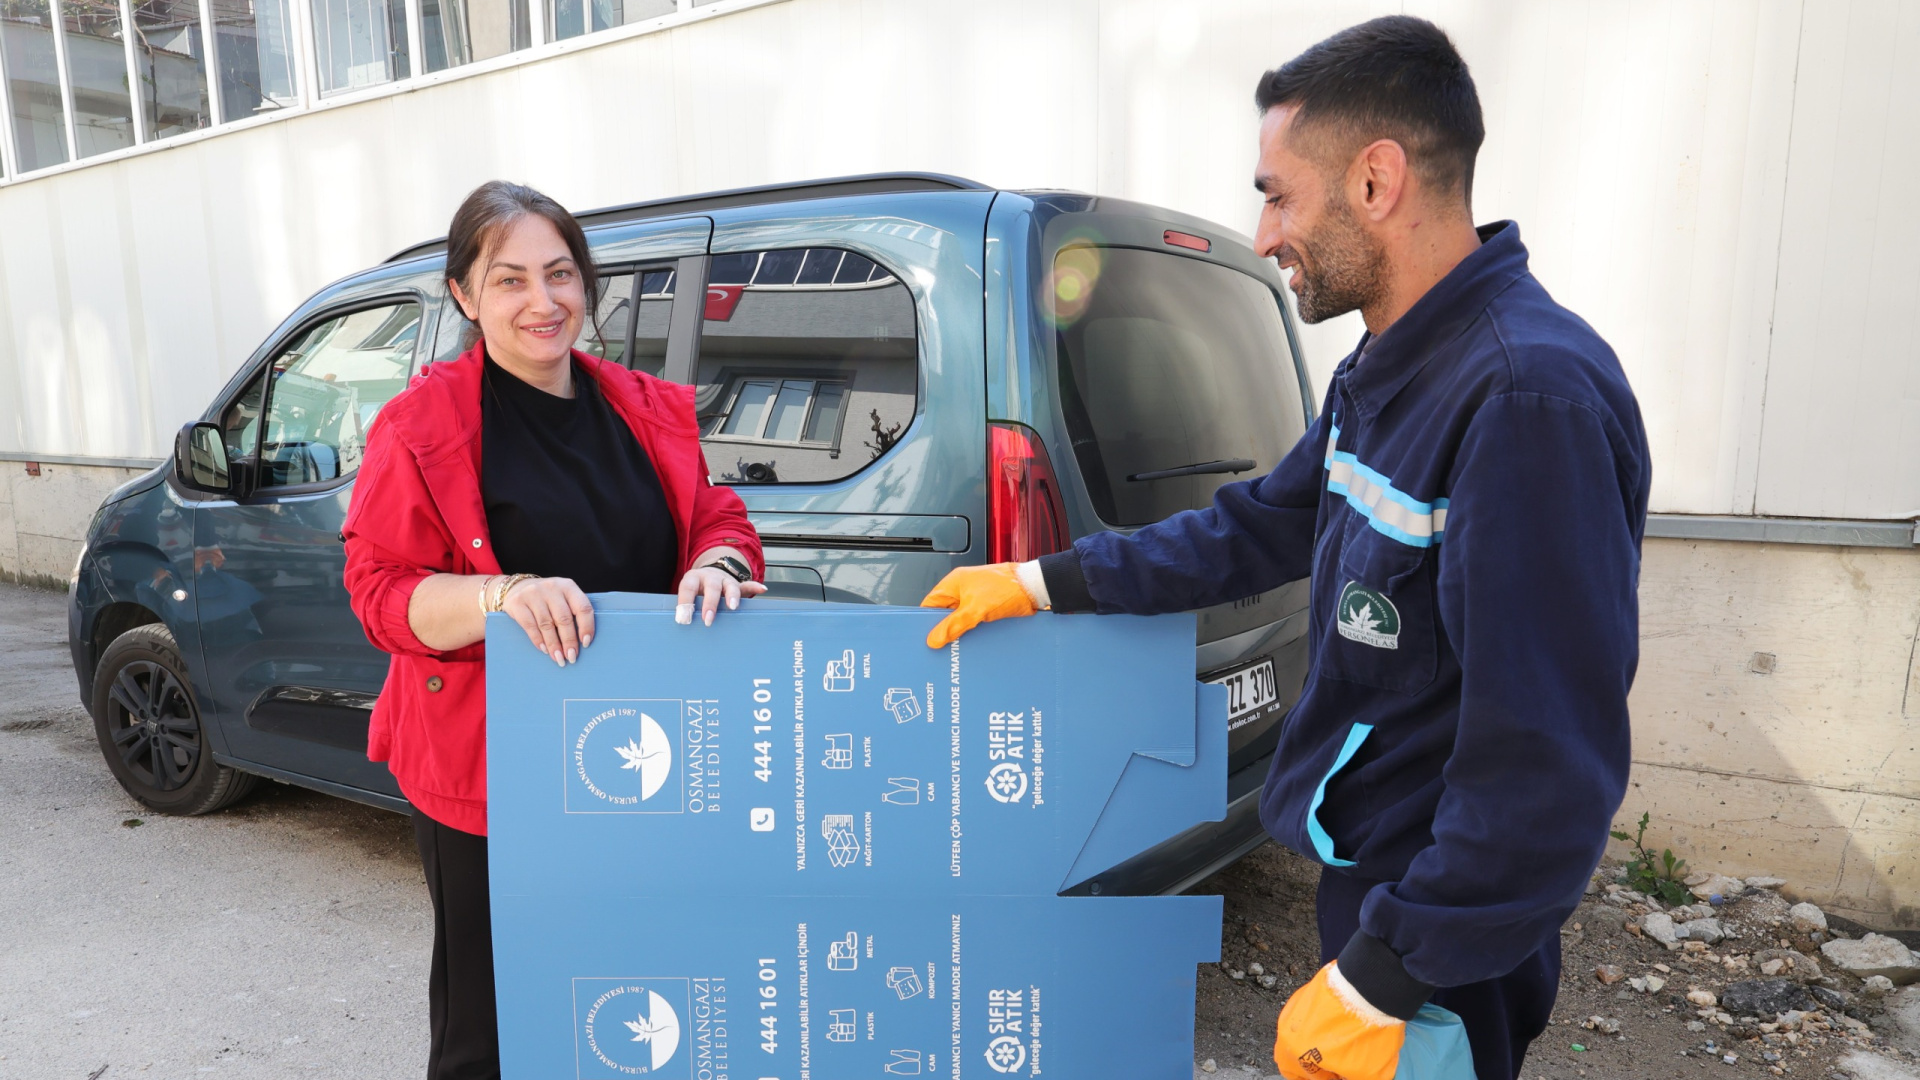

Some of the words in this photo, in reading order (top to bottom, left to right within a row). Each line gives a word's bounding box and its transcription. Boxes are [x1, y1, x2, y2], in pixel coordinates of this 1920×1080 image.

[793, 640, 806, 679] İÇİNDİR
[863, 653, 871, 678] METAL
[951, 637, 960, 684] ATMAYIN
[753, 678, 772, 703] 01
[794, 680, 804, 721] ATIKLAR
[926, 682, 934, 722] KOMPOZİT
[951, 687, 960, 724] MADDE
[1218, 675, 1247, 714] ZZ
[1250, 664, 1274, 704] 370
[576, 707, 616, 750] BELEDİYESİ
[618, 708, 637, 716] 1987
[753, 708, 772, 735] 16
[863, 737, 872, 767] PLASTİK
[951, 726, 960, 759] YANICI
[989, 711, 1006, 760] SIFIR
[1007, 711, 1024, 759] ATIK
[1031, 739, 1044, 764] değer
[685, 699, 704, 814] OSMANGAZİ
[705, 699, 721, 813] BELEDİYESİ
[754, 740, 772, 783] 444
[793, 723, 805, 798] KAZANILABİLİR
[951, 758, 960, 773] VE
[573, 751, 607, 800] OSMANGAZİ
[927, 782, 935, 802] CAM
[608, 796, 638, 805] BURSA
[795, 800, 805, 822] GERİ
[951, 774, 961, 817] YABANCI
[864, 812, 872, 867] KAĞIT-KARTON
[950, 818, 962, 837] ÇÖP
[796, 825, 806, 871] YALNIZCA
[950, 841, 961, 877] LÜTFEN
[796, 923, 810, 958] İÇİNDİR
[866, 935, 874, 958] METAL
[951, 914, 961, 964] ATMAYINIZ
[758, 958, 777, 981] 01
[799, 960, 809, 998] ATIKLAR
[928, 962, 936, 999] KOMPOZİT
[951, 966, 961, 1000] MADDE
[586, 985, 625, 1023] BELEDİYESİ
[626, 986, 645, 994] 1987
[759, 985, 777, 1010] 16
[692, 977, 713, 1080] OSMANGAZİ
[711, 977, 729, 1080] BELEDİYESİ
[867, 1011, 875, 1040] PLASTİK
[951, 1002, 961, 1032] YANICI
[988, 989, 1005, 1034] SIFIR
[1006, 989, 1023, 1033] ATIK
[1029, 1013, 1042, 1037] değer
[584, 1025, 618, 1069] OSMANGAZİ
[760, 1016, 778, 1054] 444
[799, 999, 810, 1068] KAZANILABİLİR
[951, 1033, 961, 1046] VE
[619, 1065, 649, 1075] BURSA
[800, 1070, 810, 1080] ERİ
[928, 1054, 936, 1072] CAM
[951, 1047, 961, 1080] ABANCI
